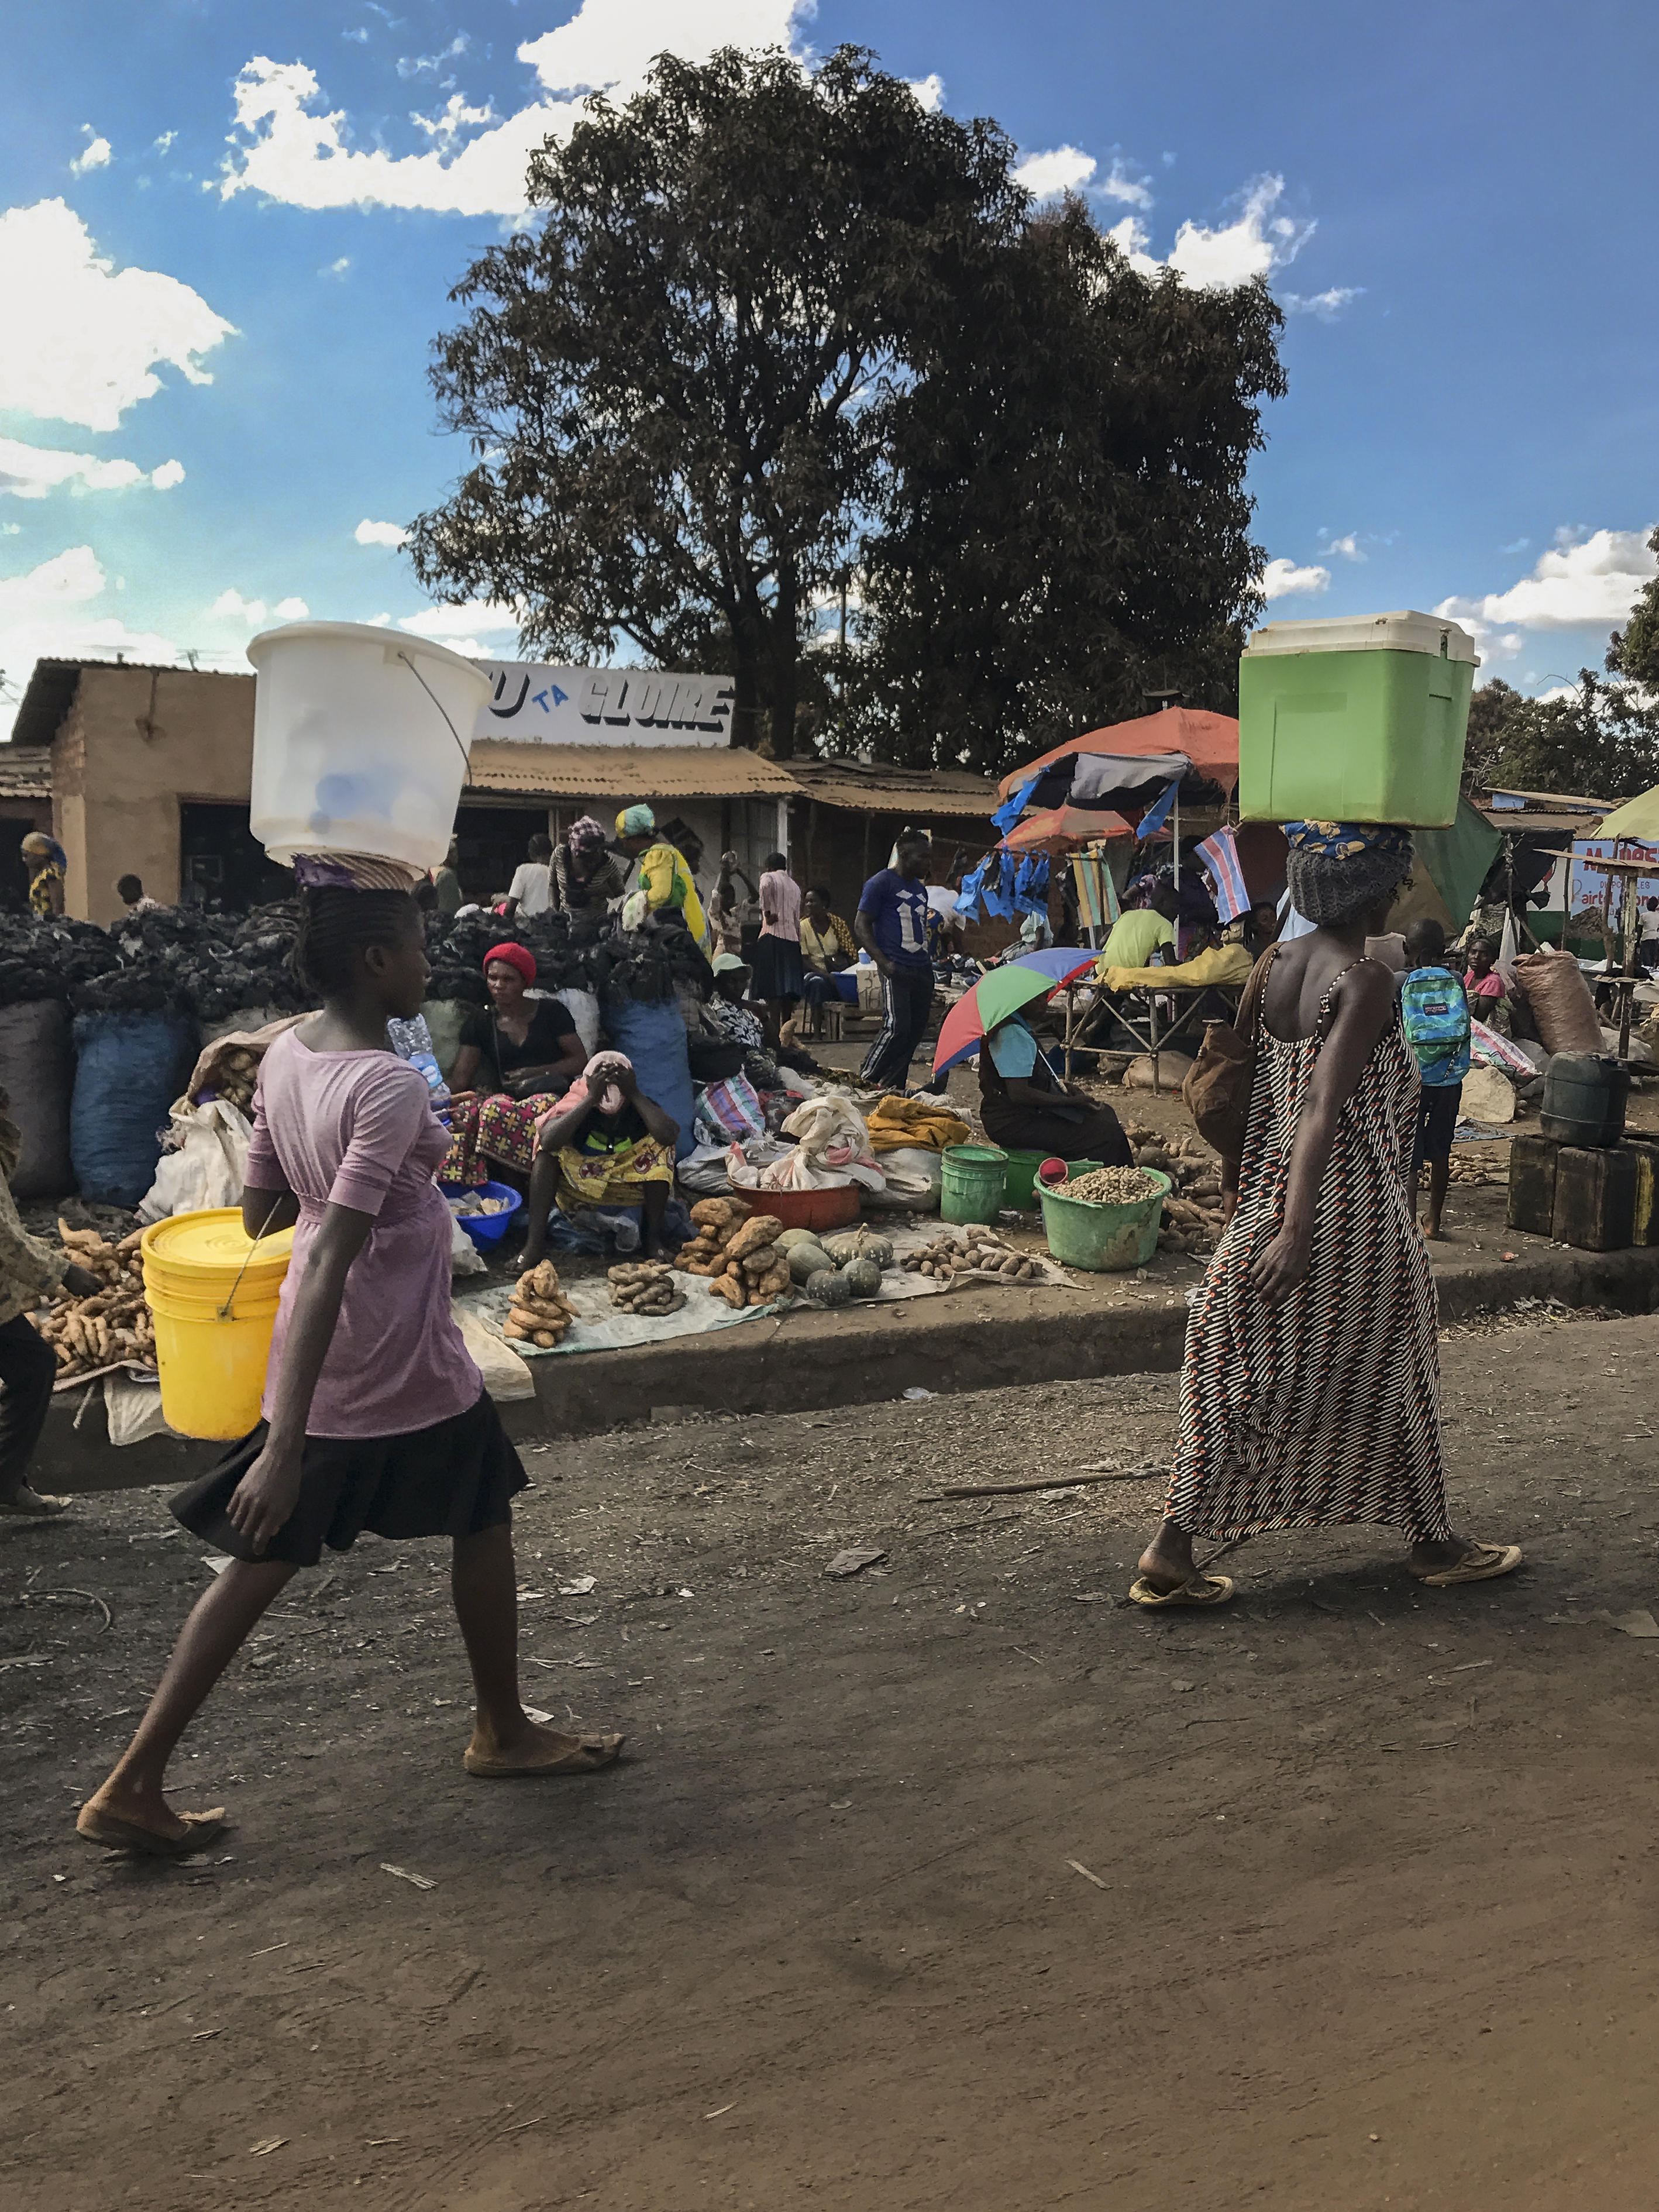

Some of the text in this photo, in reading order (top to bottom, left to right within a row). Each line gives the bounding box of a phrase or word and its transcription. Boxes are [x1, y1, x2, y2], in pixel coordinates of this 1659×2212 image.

[531, 683, 569, 713] TA
[577, 674, 735, 734] GLOIRE
[1581, 890, 1614, 906] airtl
